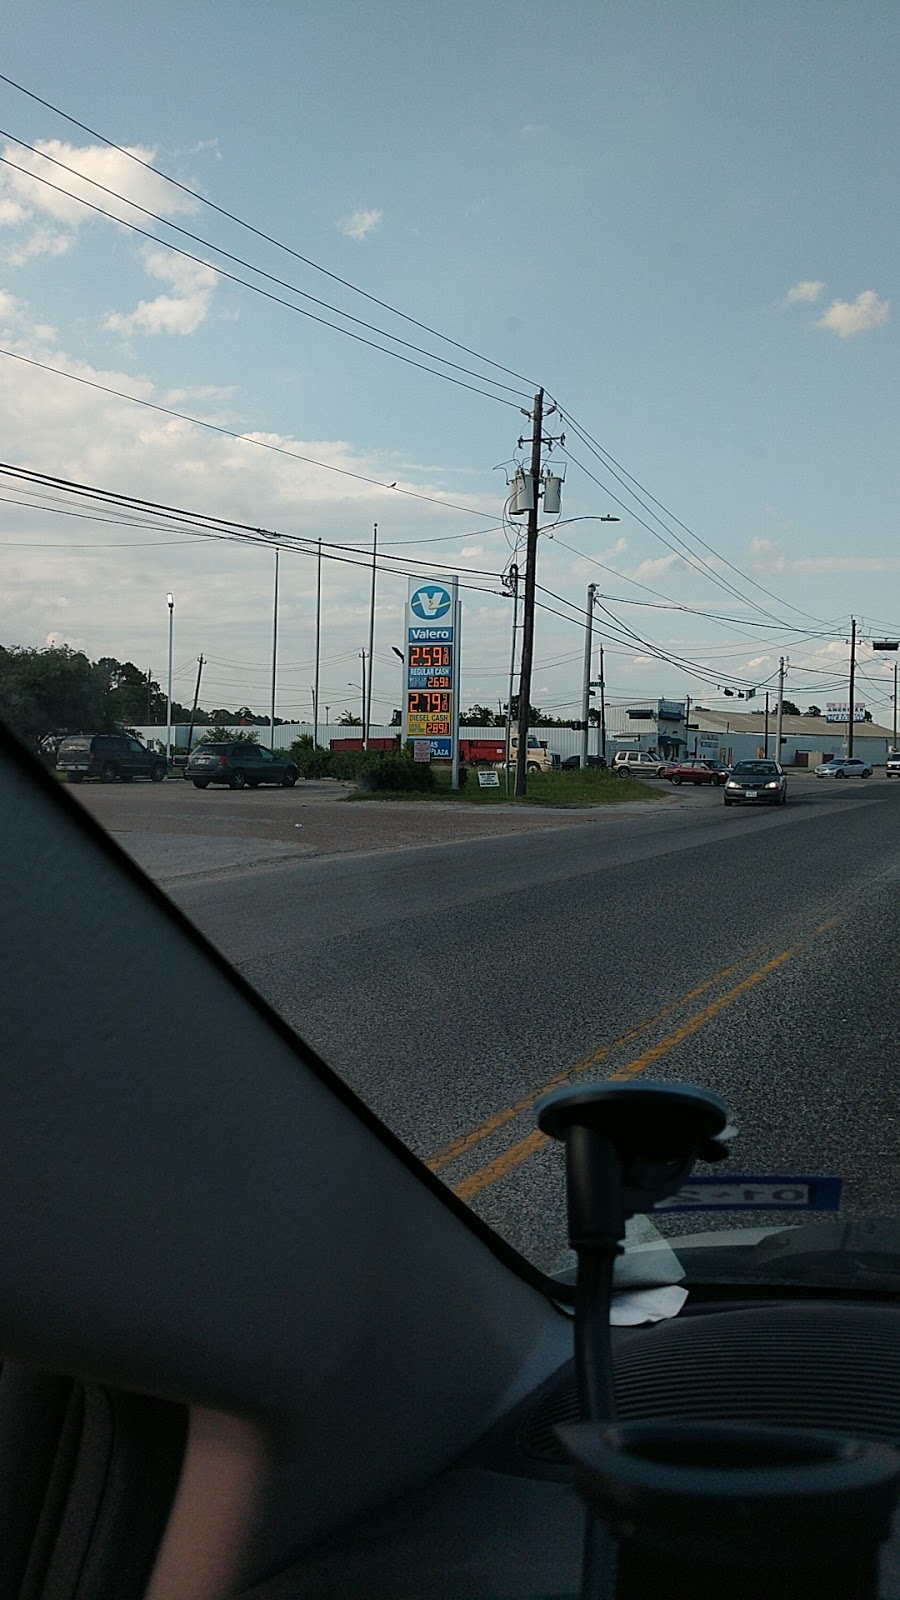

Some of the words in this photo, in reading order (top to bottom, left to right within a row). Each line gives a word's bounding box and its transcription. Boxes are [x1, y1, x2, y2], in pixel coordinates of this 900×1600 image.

[412, 629, 449, 639] Valero
[411, 647, 442, 666] 2.59
[410, 668, 434, 676] REGULAR
[410, 693, 441, 712] 2.79
[429, 747, 449, 756] PLAZA
